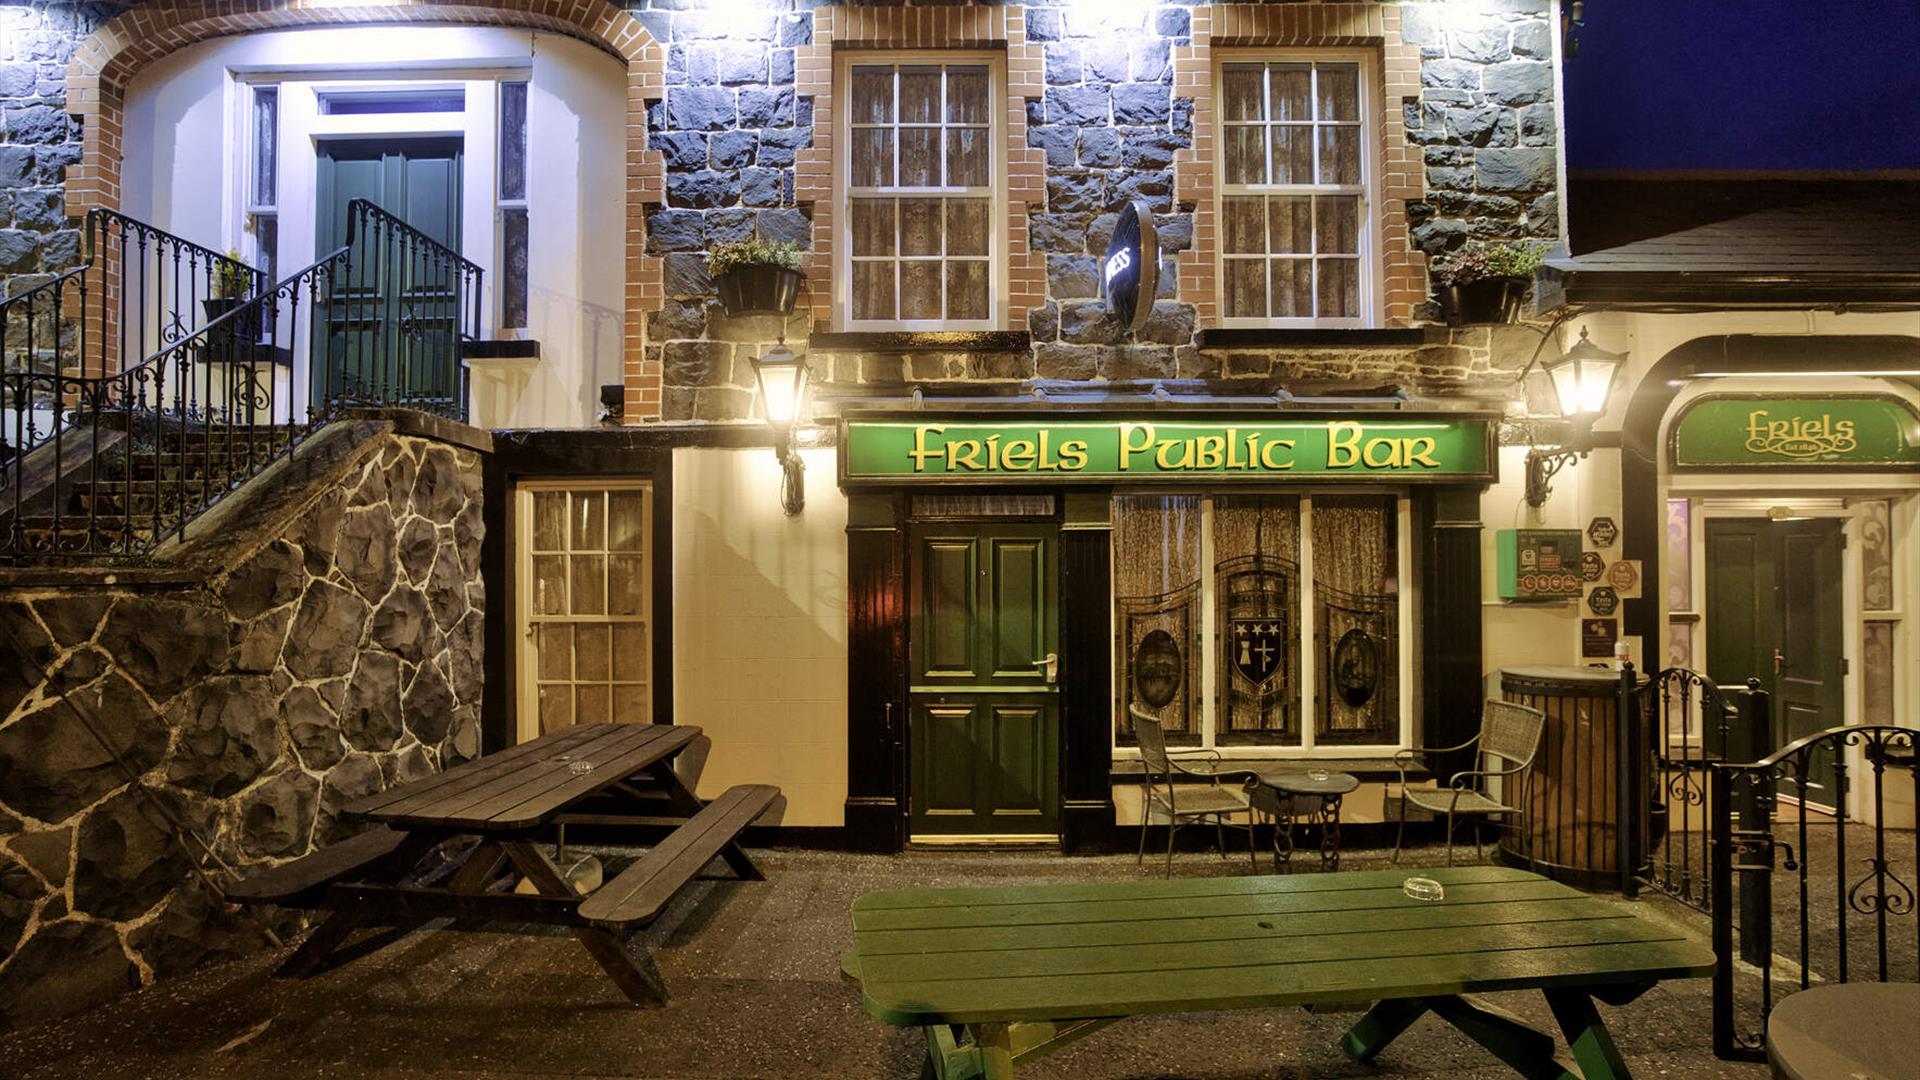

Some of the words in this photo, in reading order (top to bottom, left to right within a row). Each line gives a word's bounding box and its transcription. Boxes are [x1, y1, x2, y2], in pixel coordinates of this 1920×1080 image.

[1745, 410, 1855, 439] Friels
[908, 424, 1089, 471] Friels
[1118, 422, 1296, 471] Public
[1326, 420, 1441, 469] Bar
